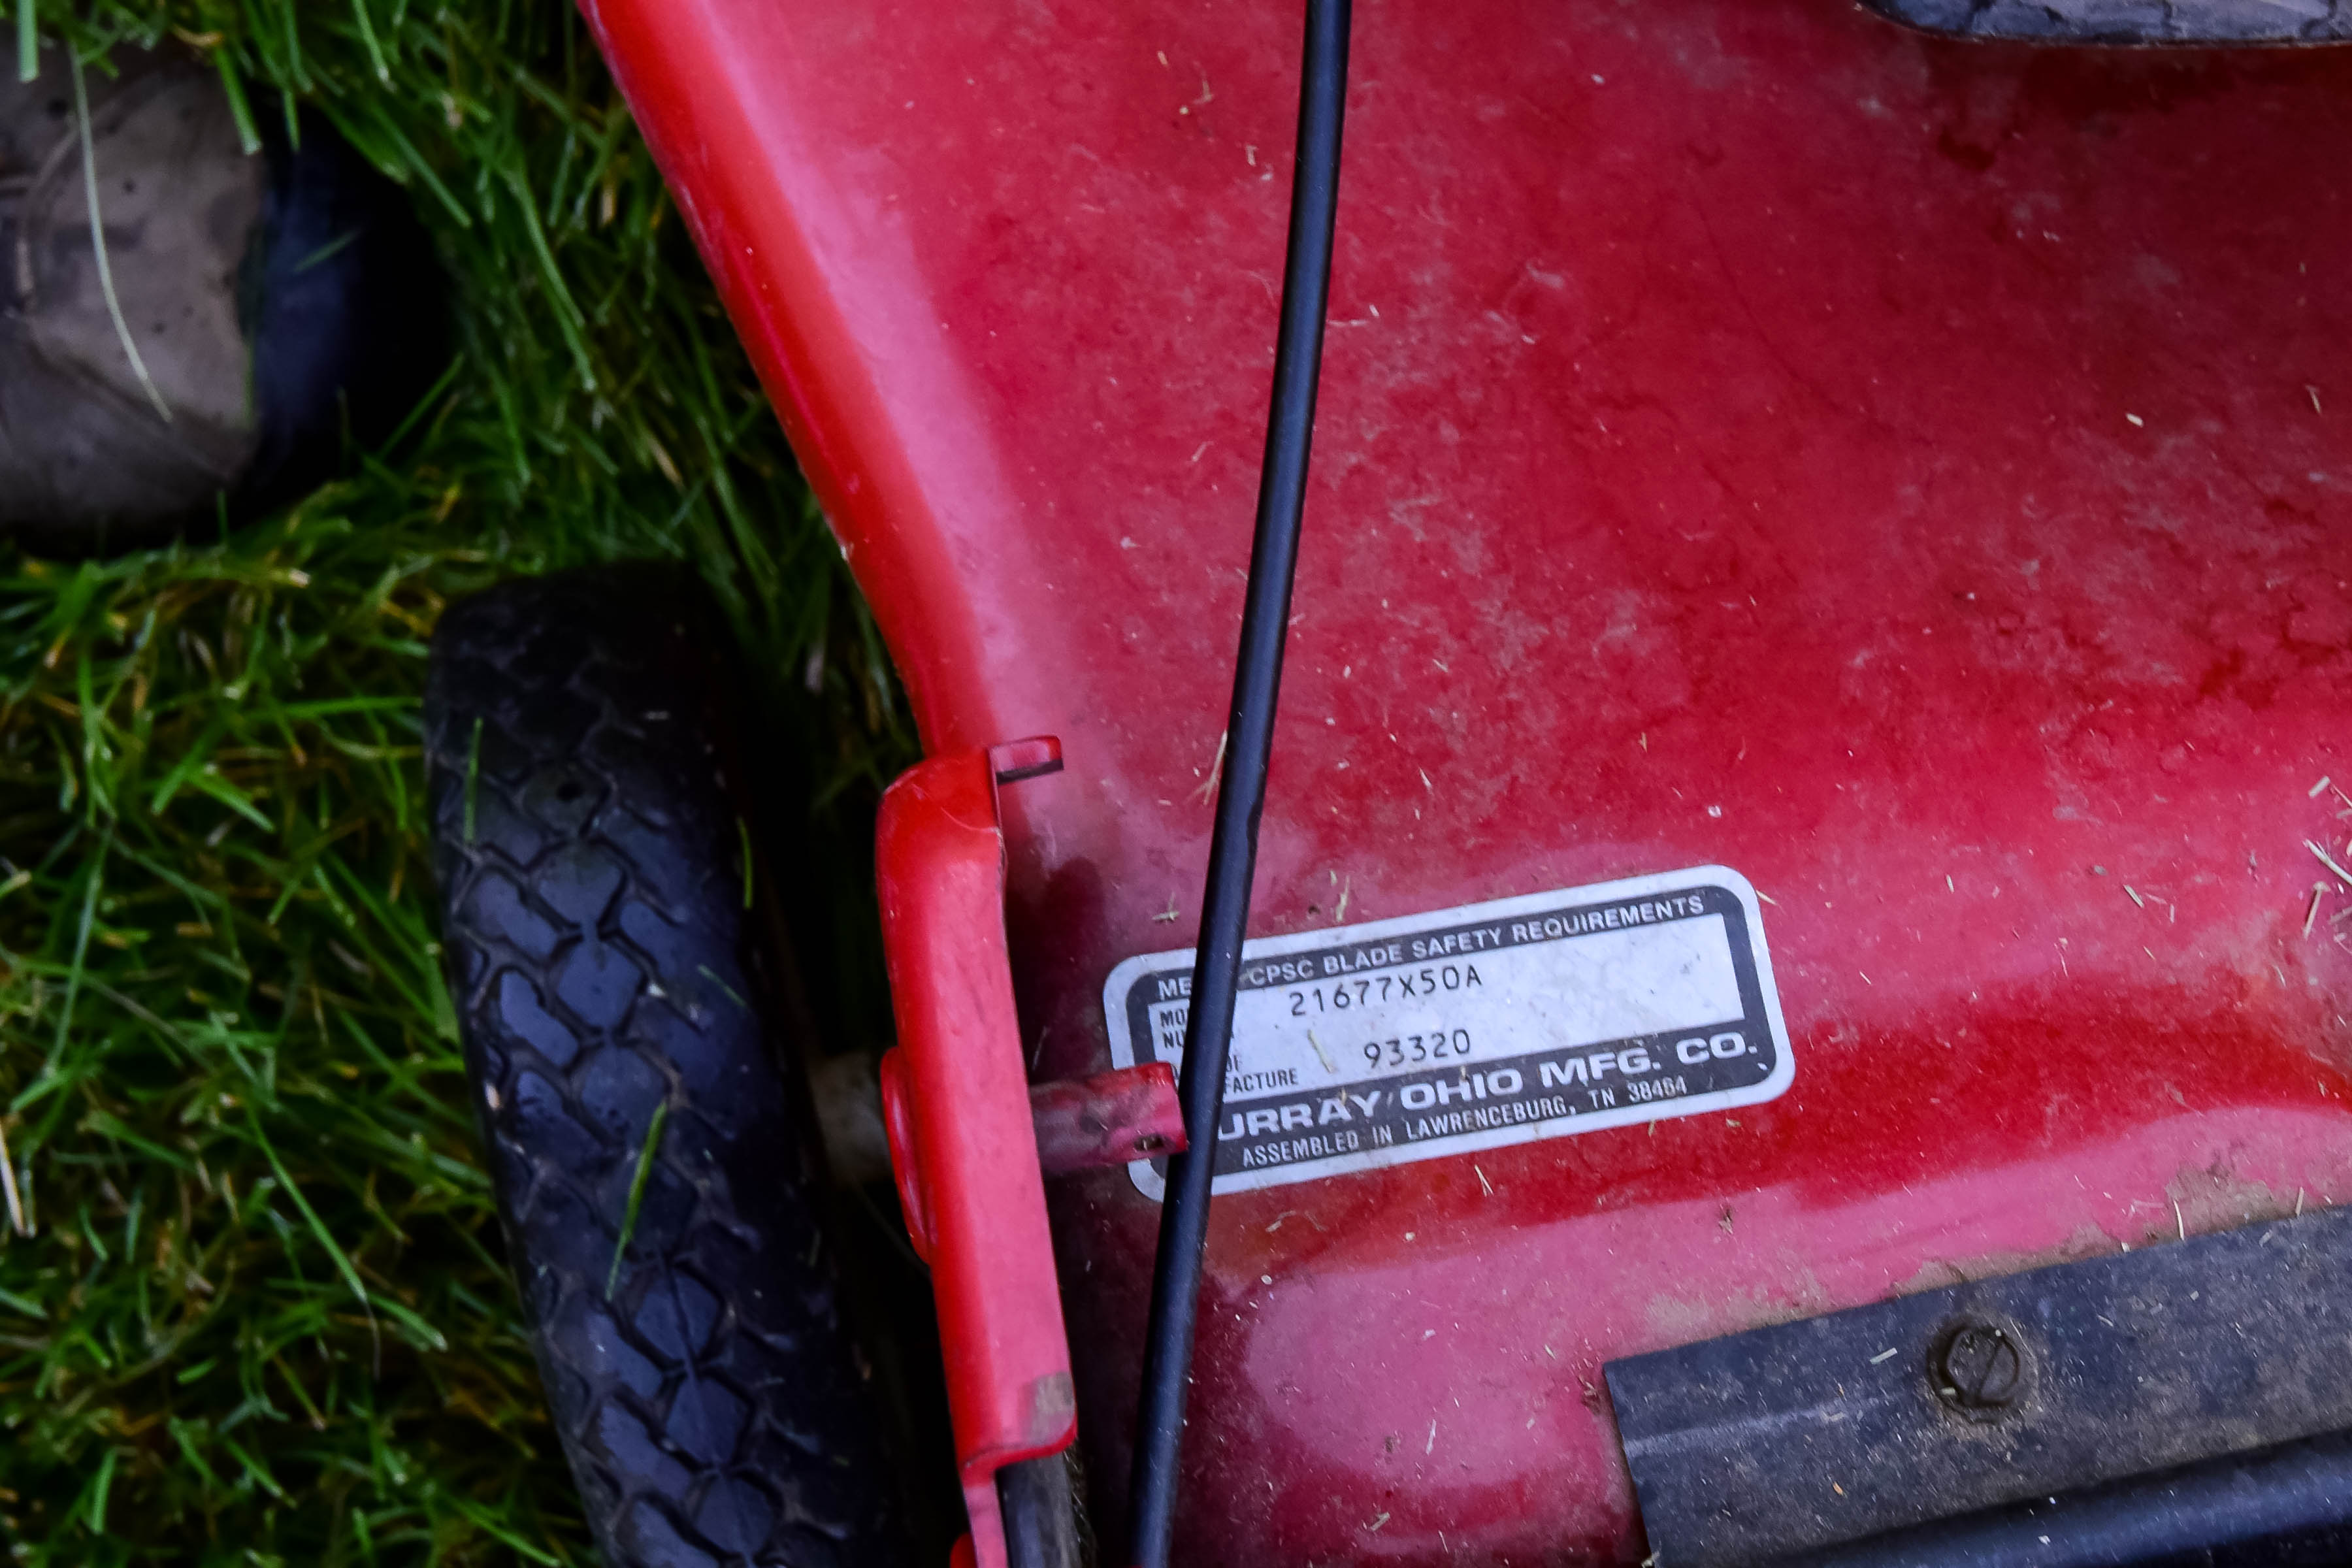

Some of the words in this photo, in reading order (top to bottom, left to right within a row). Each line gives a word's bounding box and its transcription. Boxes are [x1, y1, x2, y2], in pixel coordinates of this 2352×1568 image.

[1249, 959, 1315, 986] CPSC
[1322, 944, 1403, 974] BLADE
[1411, 926, 1501, 959] SAFETY
[1511, 895, 1704, 942] REQUIREMENTS
[1288, 964, 1482, 1017] 21677X50A
[1222, 1068, 1299, 1094] FACTURE
[1364, 1029, 1470, 1068] 93320
[1217, 1090, 1381, 1141] URRAY
[1399, 1068, 1524, 1110] OHIO
[1539, 1047, 1661, 1088] MFG.
[1676, 1032, 1758, 1065] CO.
[1243, 1130, 1360, 1168] ASSEMBLED
[1372, 1124, 1394, 1147] IN
[1405, 1095, 1577, 1140] LAWRENCEBURG,
[1588, 1086, 1616, 1109] TN
